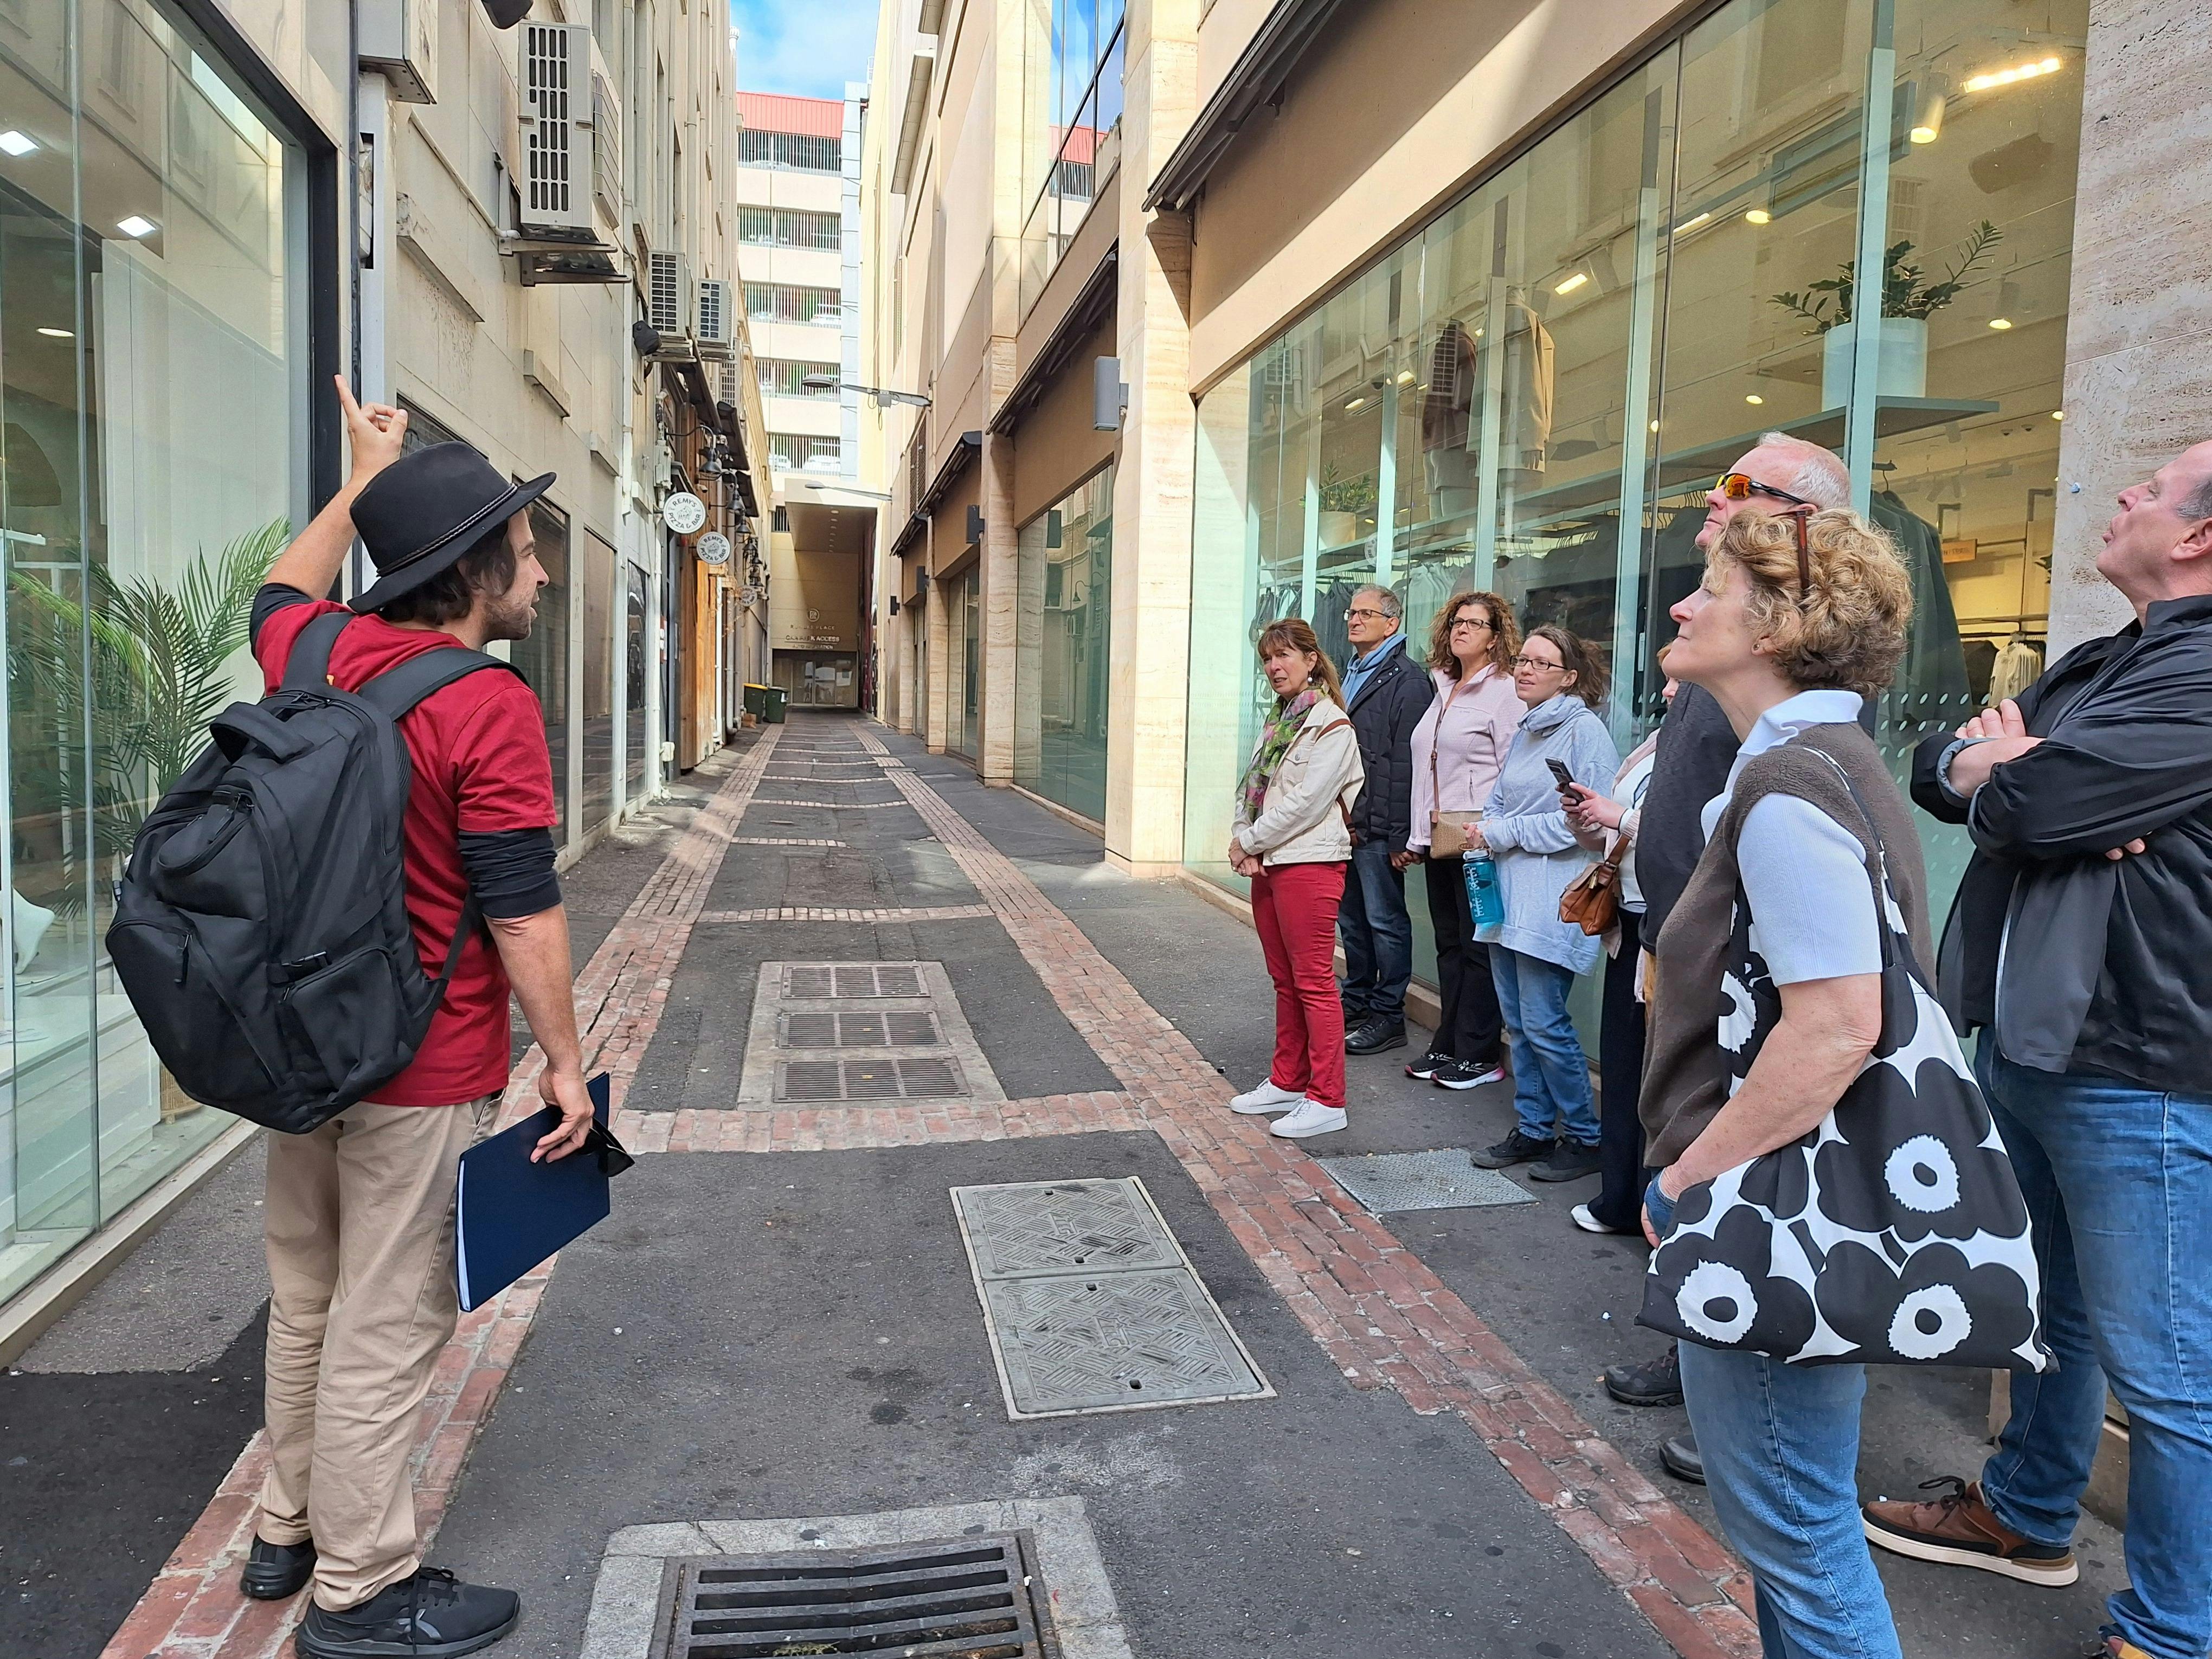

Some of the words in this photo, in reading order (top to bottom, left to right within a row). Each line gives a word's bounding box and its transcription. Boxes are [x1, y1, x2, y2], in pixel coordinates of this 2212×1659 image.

[672, 498, 697, 507] REMY'S
[668, 512, 684, 529] PIZZA
[692, 514, 701, 526] BAR
[700, 548, 713, 561] PIZZA
